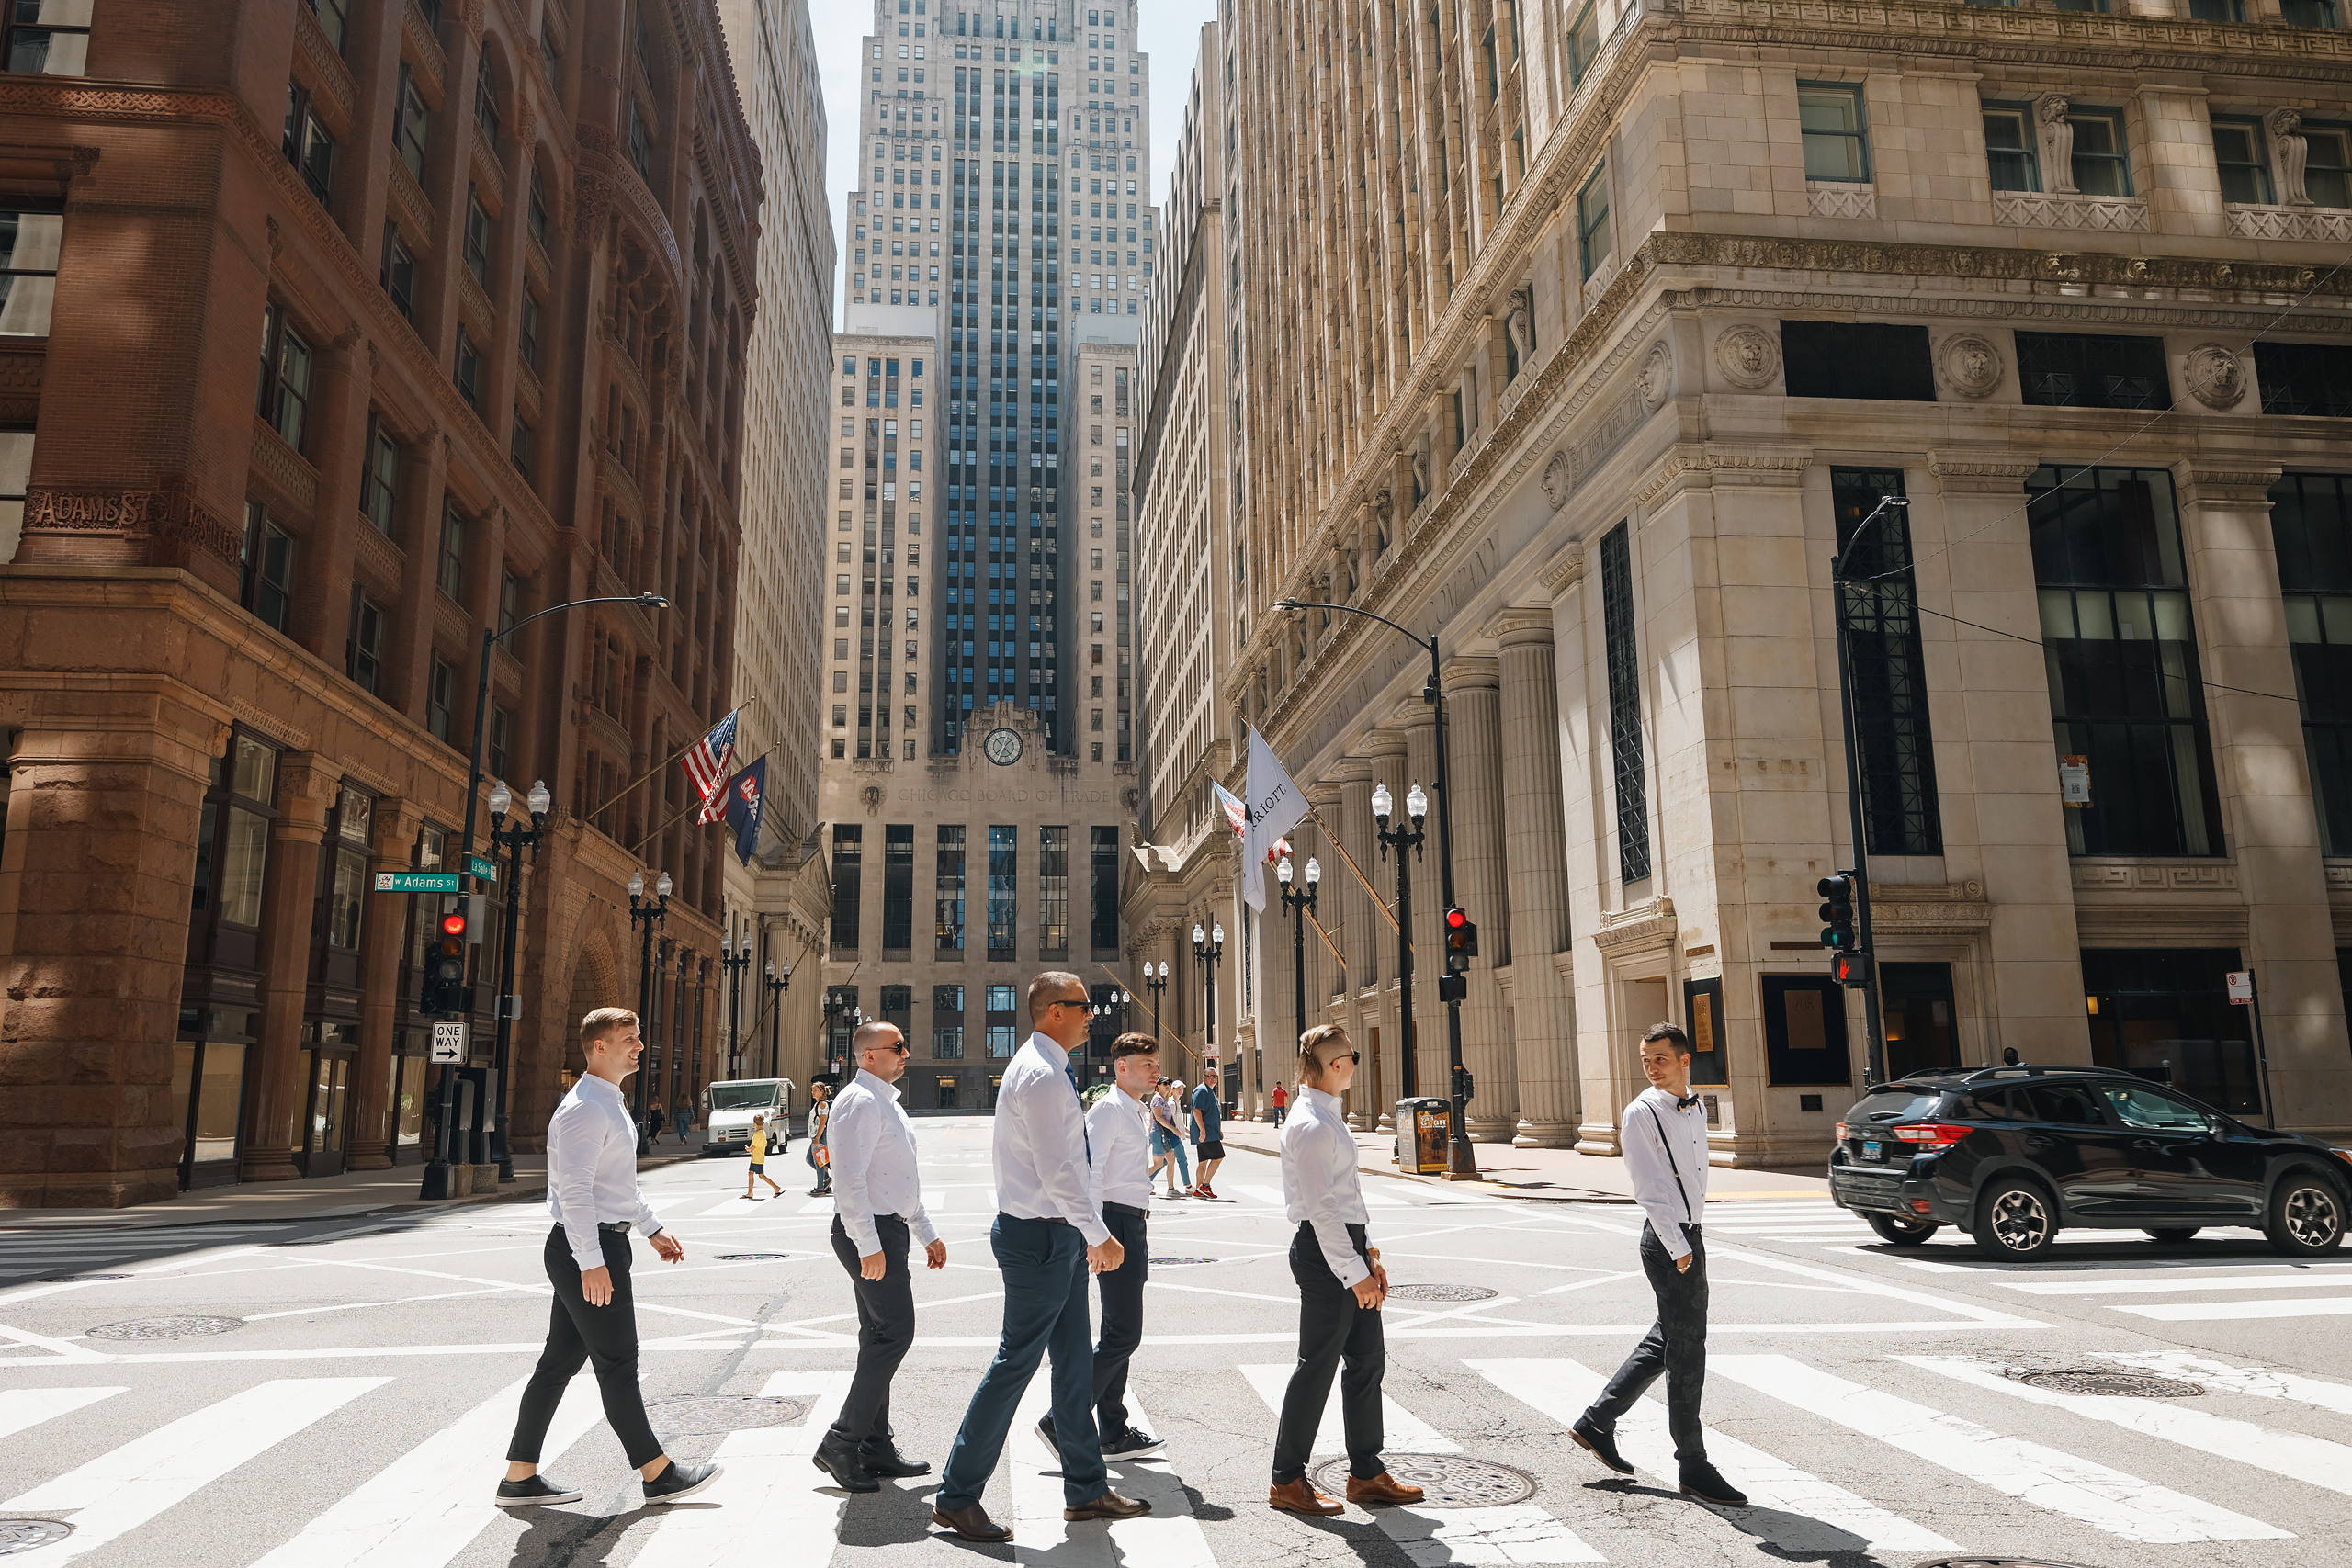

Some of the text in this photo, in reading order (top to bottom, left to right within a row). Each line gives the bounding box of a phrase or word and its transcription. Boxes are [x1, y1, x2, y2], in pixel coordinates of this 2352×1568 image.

[35, 491, 148, 525] ADAMS ST
[404, 876, 444, 888] Adams
[1792, 996, 1815, 1012] 208
[437, 1026, 460, 1036] ONE
[435, 1037, 460, 1047] WAY
